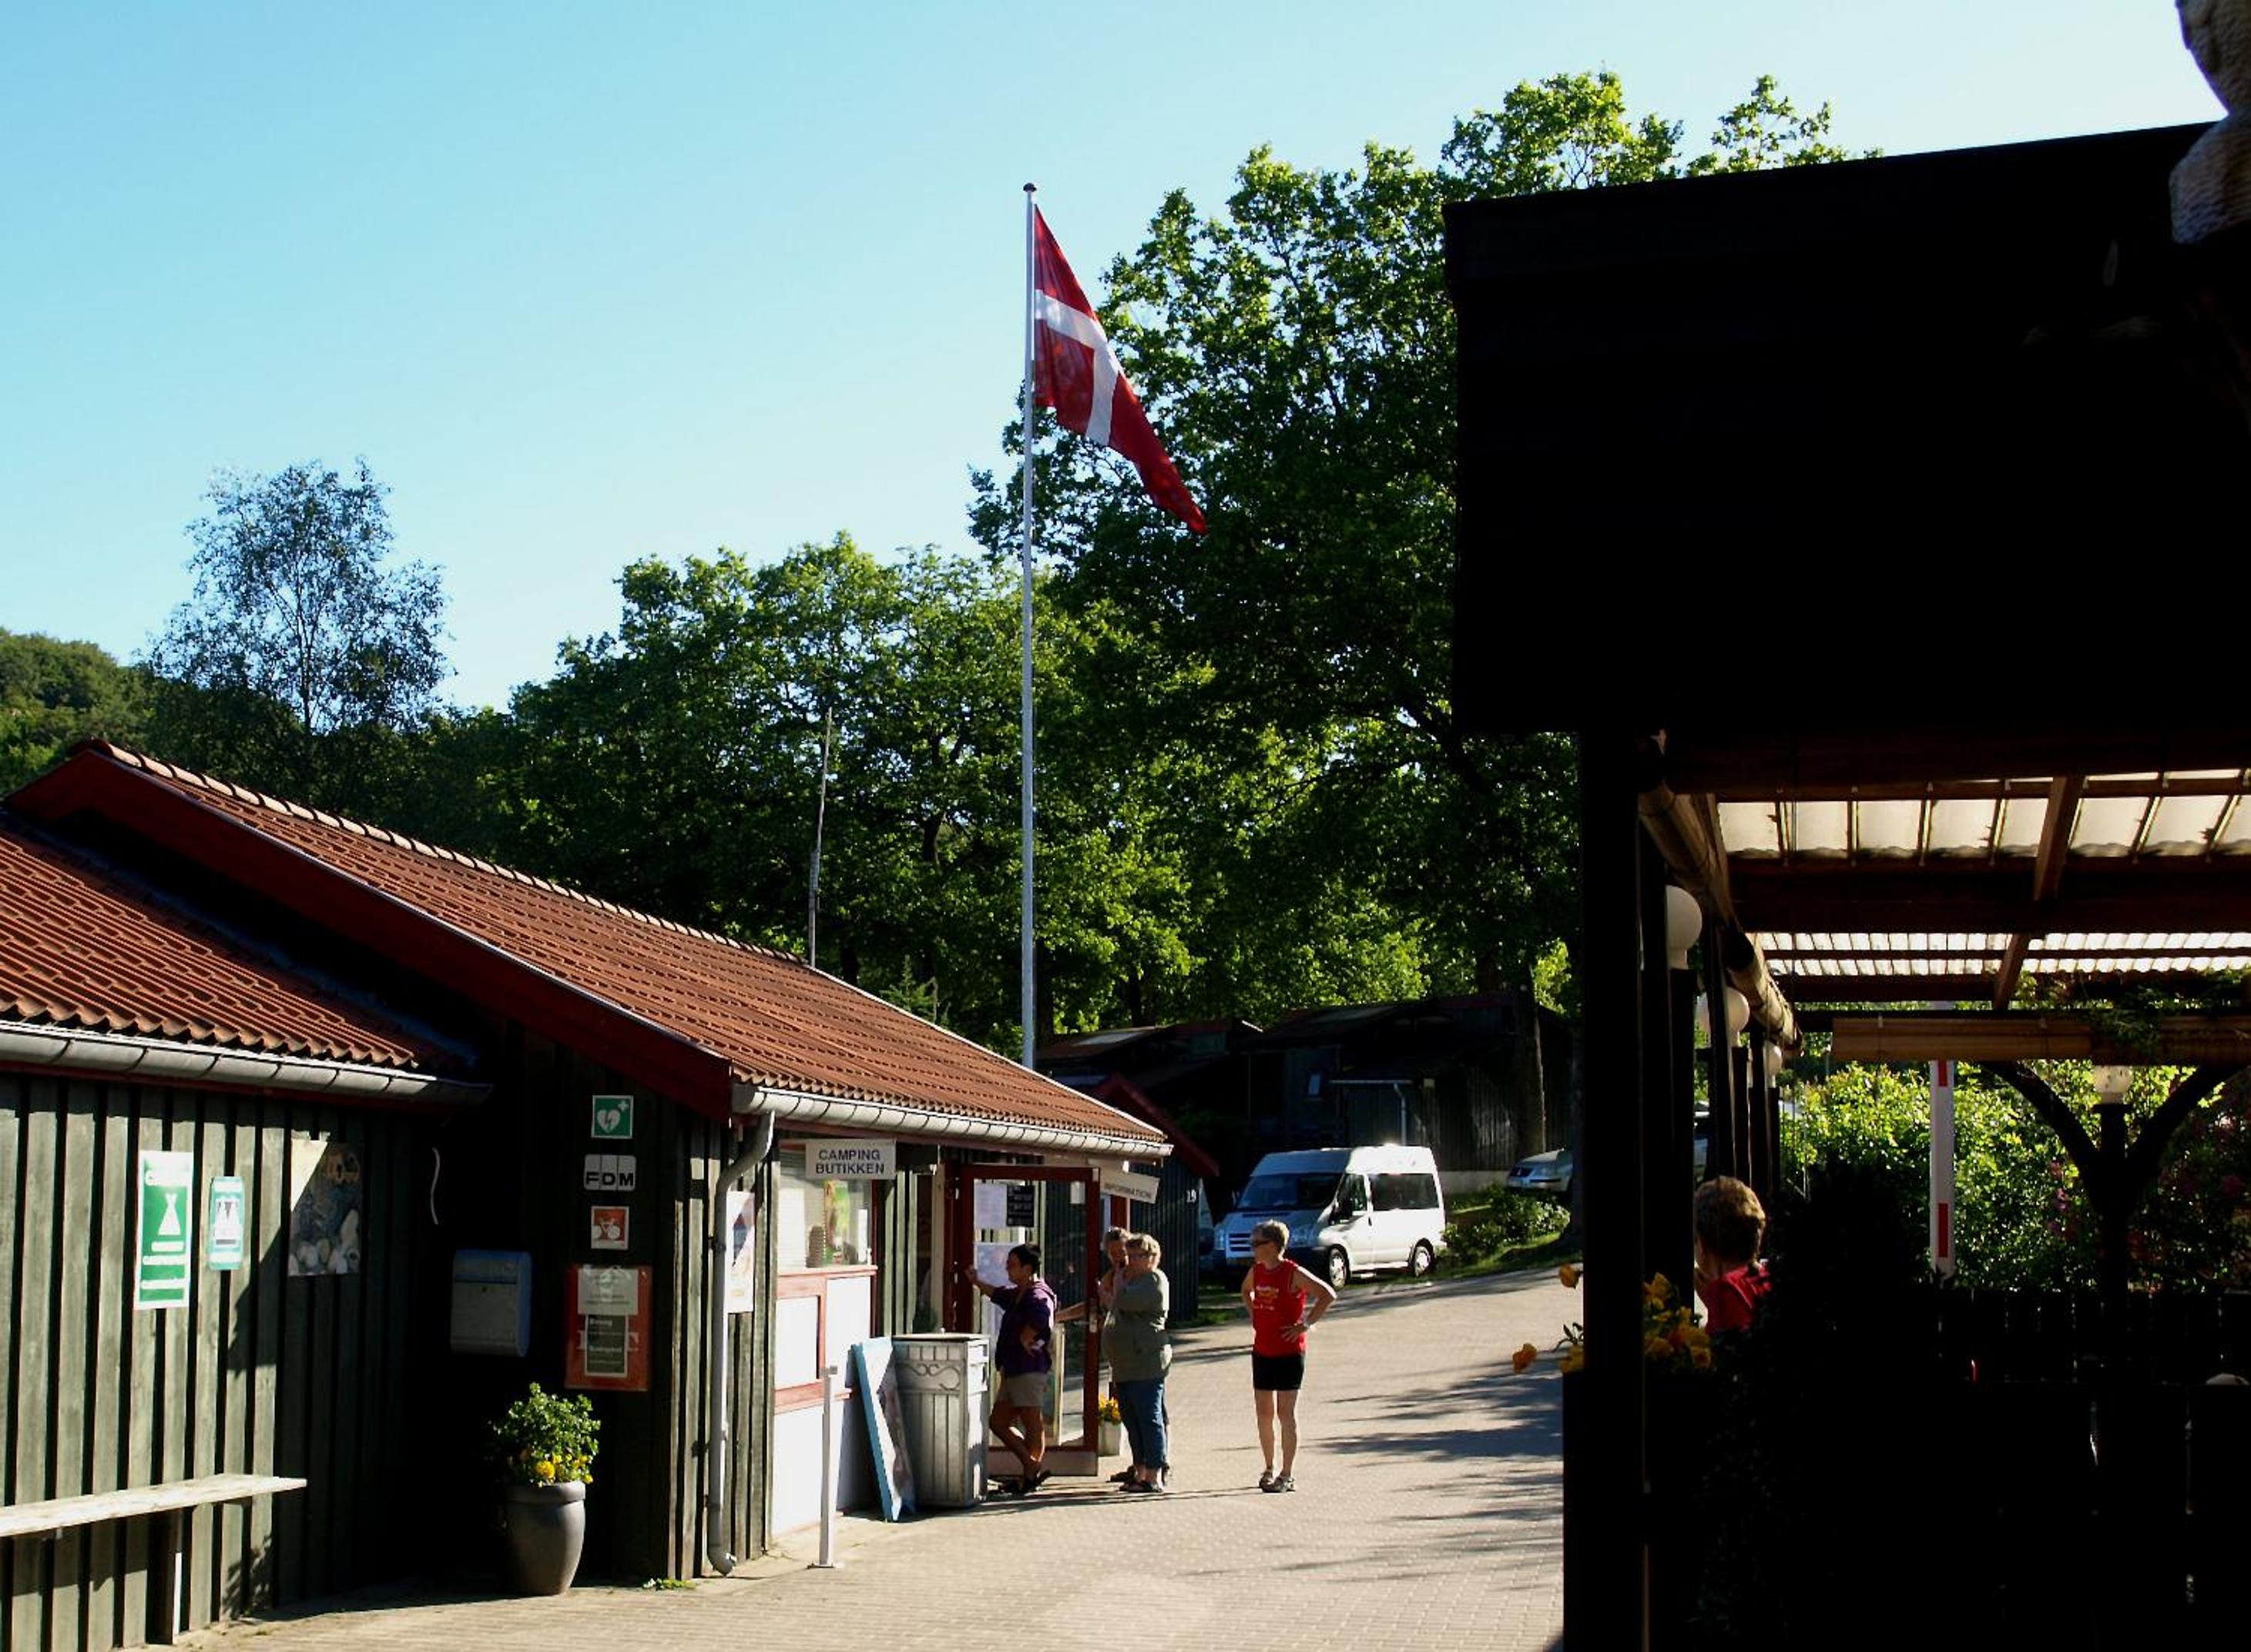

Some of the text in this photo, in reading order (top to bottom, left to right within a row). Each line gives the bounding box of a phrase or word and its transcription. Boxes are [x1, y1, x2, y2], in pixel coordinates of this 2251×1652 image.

[818, 1148, 881, 1161] CAMPING
[816, 1162, 884, 1174] BUTIKKEN
[585, 1171, 634, 1187] FDM
